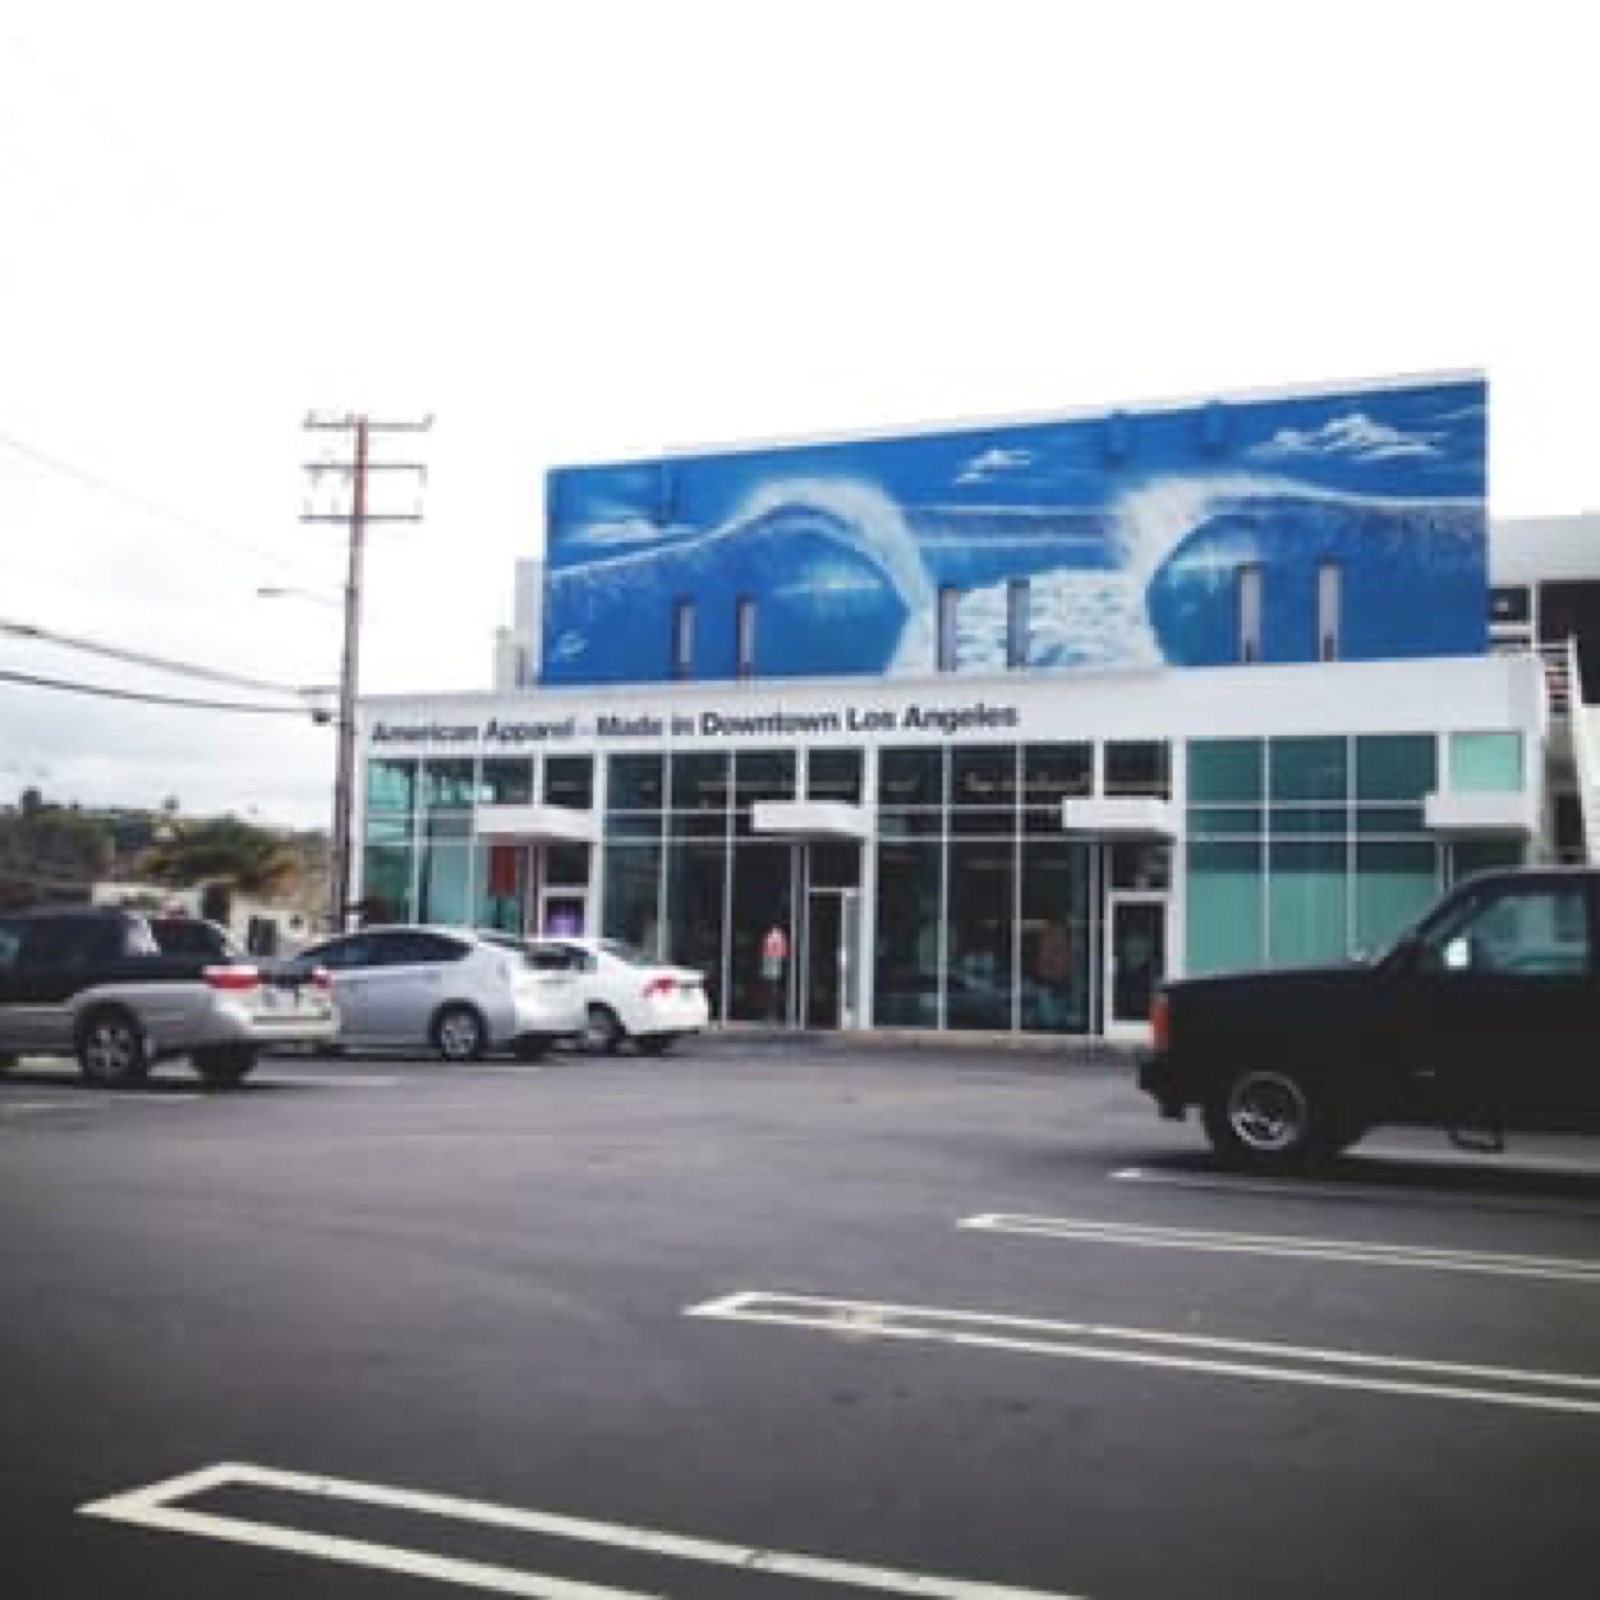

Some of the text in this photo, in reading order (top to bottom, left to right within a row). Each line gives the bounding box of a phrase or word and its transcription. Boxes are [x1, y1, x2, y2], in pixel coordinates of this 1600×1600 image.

[596, 714, 663, 737] Made
[671, 714, 696, 737] in
[701, 711, 840, 735] Downtown
[846, 706, 897, 732] Los
[902, 703, 1020, 735] Angeles
